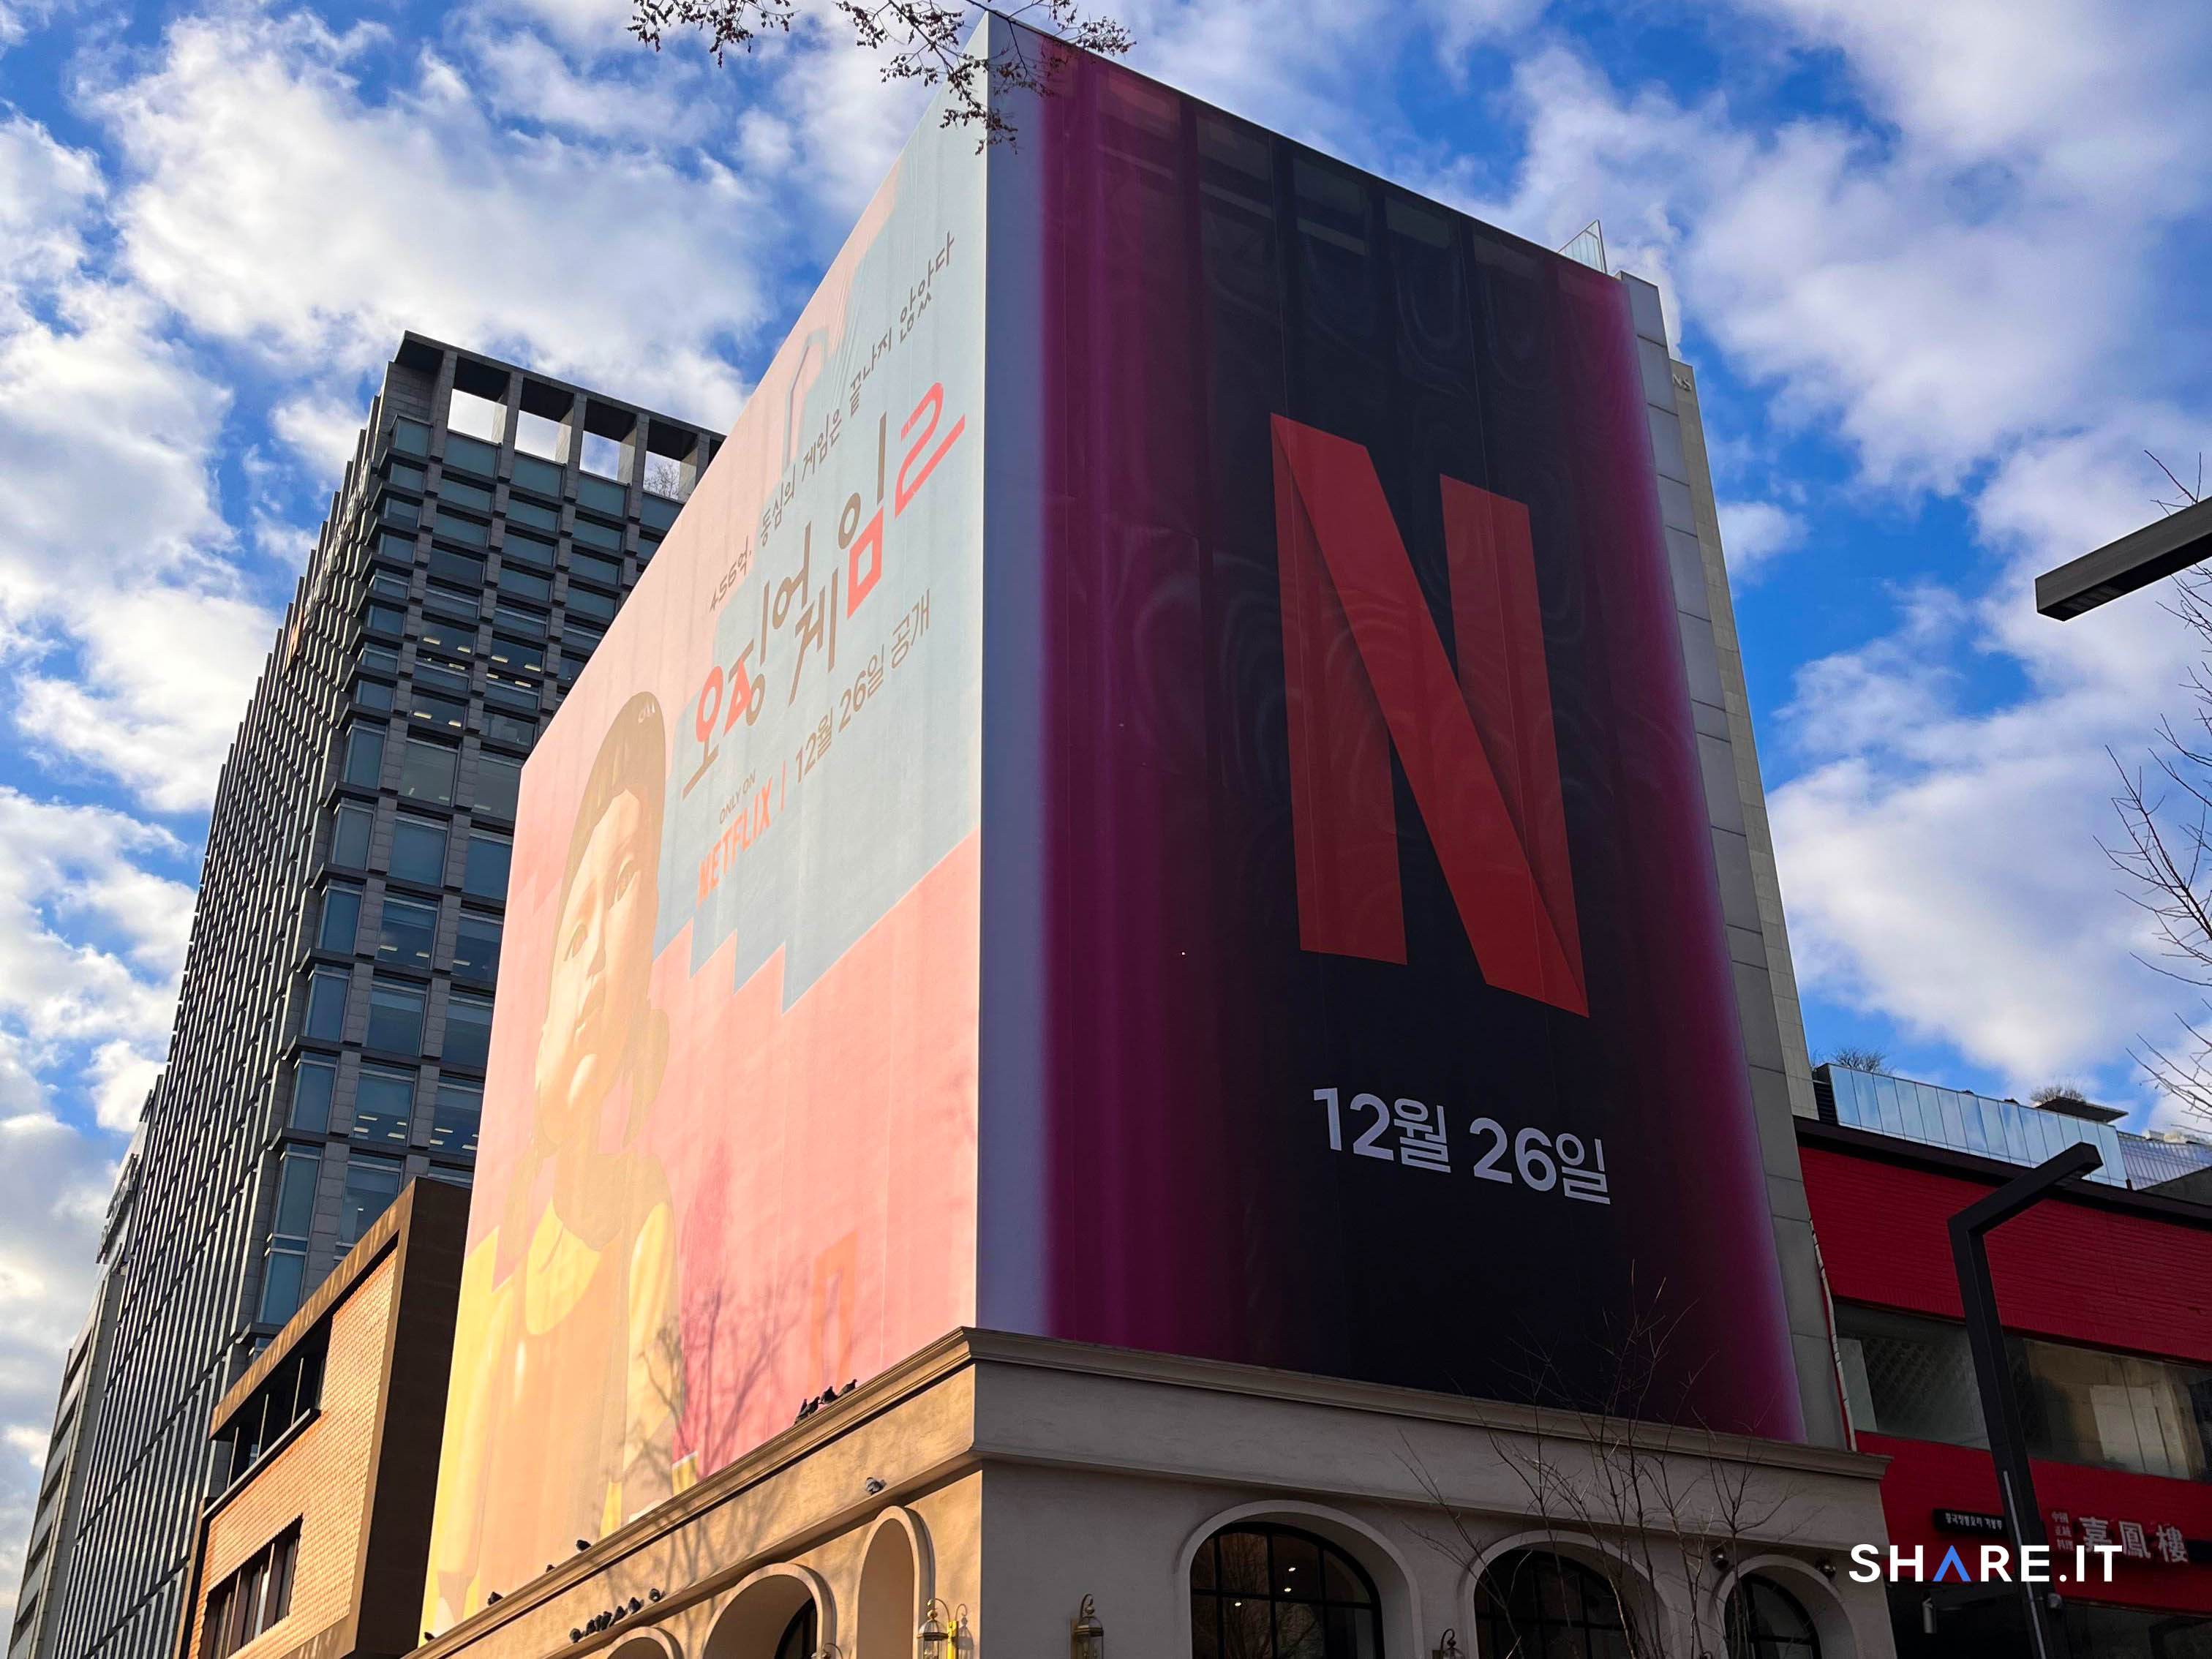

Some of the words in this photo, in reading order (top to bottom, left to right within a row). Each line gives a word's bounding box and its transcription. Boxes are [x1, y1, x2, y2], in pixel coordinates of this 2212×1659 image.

[761, 464, 796, 547] 동심의
[802, 408, 840, 483] 게임은
[850, 326, 892, 418] 끝나지
[900, 230, 955, 344] 않았다
[682, 520, 812, 802] 오징어
[796, 707, 833, 783] 12월
[838, 644, 885, 733] 26일
[891, 588, 930, 670] 공개
[1270, 413, 1590, 1018] N
[696, 775, 773, 911] NETFLIX
[720, 788, 741, 825] ONLY
[742, 769, 756, 795] ON
[1313, 1087, 1451, 1173] 12월
[1469, 1117, 1611, 1205] 26일
[2079, 1516, 2189, 1563] 嘉鳳樓
